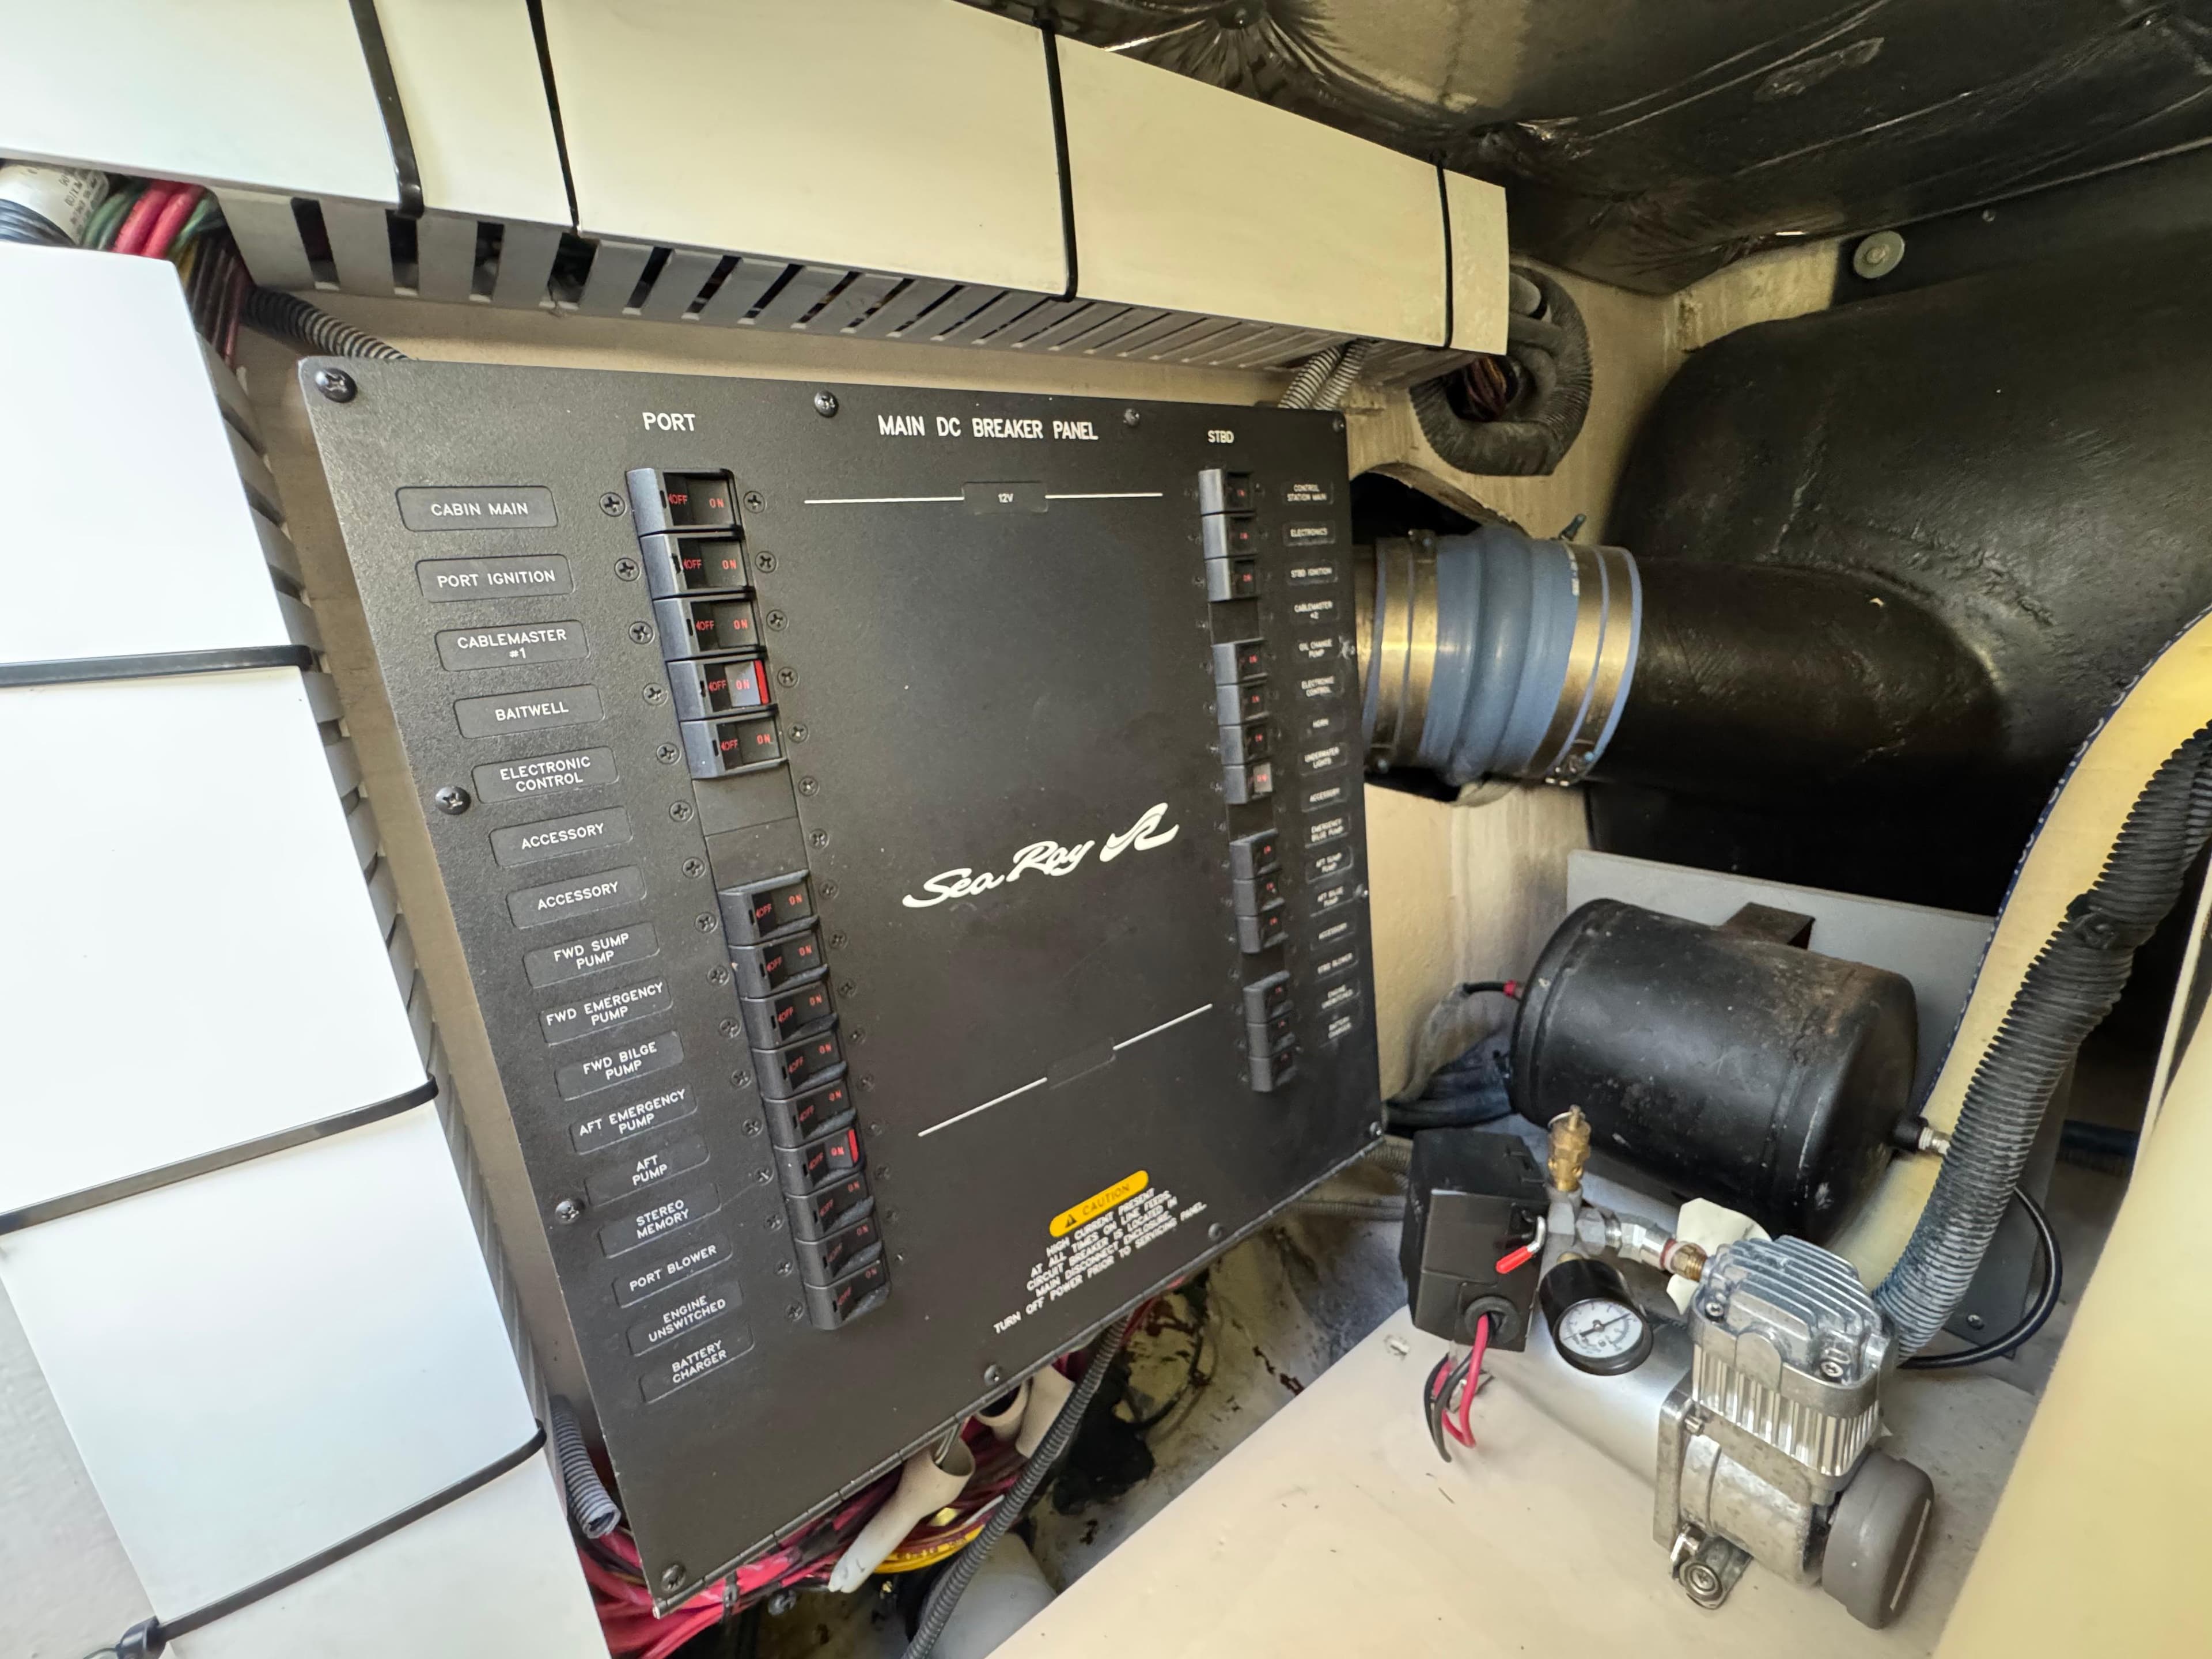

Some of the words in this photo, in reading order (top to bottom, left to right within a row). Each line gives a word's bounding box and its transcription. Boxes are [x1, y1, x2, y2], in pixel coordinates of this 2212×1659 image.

[642, 412, 696, 431] PORT
[878, 415, 925, 437] MAIN
[937, 417, 960, 437] DC
[972, 418, 1043, 439] BREAKER
[1053, 421, 1099, 440] PANEL
[1207, 430, 1234, 444] STBD
[709, 498, 724, 507] ON
[998, 493, 1014, 502] 12V
[431, 502, 481, 516] CABIN
[488, 503, 529, 516] MAIN
[1290, 528, 1328, 537] ELECTRONICS
[722, 559, 737, 569] ON
[437, 574, 479, 588] PORT
[488, 570, 555, 585] IGNITION
[1294, 601, 1333, 612] CABLEMASTER
[734, 620, 748, 629] ON
[457, 628, 567, 650] CABLEMASTER
[509, 647, 527, 659] #1
[735, 680, 749, 690] ON
[1301, 675, 1334, 690] ELECTRONIC
[1306, 686, 1331, 696] CONTROL
[495, 701, 569, 721] BAITWELL
[1313, 718, 1328, 728] HORN
[756, 735, 771, 744] ON
[1305, 747, 1340, 762] UNDERWATER
[1313, 757, 1332, 768] LIGHTS
[500, 756, 591, 781] ELECTRONIC
[515, 772, 584, 791] CONTROL
[1310, 787, 1340, 802] ACCESSORY
[521, 824, 604, 849] ACCESSORY
[902, 868, 1005, 908] Sea
[1006, 840, 1096, 882] Ray
[537, 881, 618, 910] ACCESSORY
[789, 894, 802, 906] ON
[552, 946, 588, 963] FWD
[590, 933, 629, 956] SUMP
[799, 945, 812, 956] ON
[575, 949, 615, 968] PUMP
[546, 1009, 578, 1025] FWD
[584, 983, 663, 1014] EMERGENCY
[808, 994, 823, 1006] ON
[591, 1006, 628, 1025] PUMP
[819, 1044, 832, 1054] ON
[584, 1058, 614, 1077] FWD
[619, 1041, 657, 1066] BILGE
[605, 1060, 643, 1080] PUMP
[829, 1090, 842, 1101] ON
[579, 1118, 604, 1136] AFT
[609, 1089, 686, 1126] EMERGENCY
[618, 1113, 656, 1134] PUMP
[830, 1144, 845, 1155] ON
[637, 1154, 658, 1171] AFT
[632, 1164, 668, 1185] PUMP
[848, 1181, 860, 1192] ON
[1082, 1184, 1130, 1216] CAUTION
[636, 1199, 685, 1226] STEREO
[636, 1208, 690, 1238] MEMORY
[1046, 1237, 1070, 1257] HIGH
[1074, 1212, 1114, 1238] CURRENT
[1118, 1188, 1155, 1214] PRESENT
[1027, 1264, 1065, 1291] CIRCUIT
[1069, 1238, 1109, 1266] BREAKER
[1113, 1229, 1123, 1240] IS
[1127, 1205, 1163, 1232] LOCATED
[1168, 1196, 1177, 1209] IN
[1031, 1264, 1043, 1277] AT
[1048, 1252, 1067, 1267] ALL
[1071, 1232, 1099, 1252] TIMES
[1104, 1221, 1117, 1234] ON
[1120, 1207, 1140, 1225] LINE
[629, 1269, 662, 1291] PORT
[667, 1245, 717, 1275] BLOWER
[994, 1311, 1021, 1334] TURN
[1025, 1299, 1044, 1315] OFF
[1050, 1275, 1083, 1301] POWER
[1088, 1257, 1115, 1278] PRIOR
[1119, 1247, 1131, 1257] TO
[1135, 1217, 1177, 1248] SERVICING
[1036, 1277, 1061, 1297] MAIN
[1065, 1244, 1119, 1280] DISCONNECT
[663, 1296, 707, 1323] ENGINE
[647, 1300, 726, 1342] UNSWITCHED
[671, 1339, 723, 1373] BATTERY
[671, 1347, 727, 1384] CHARGER
